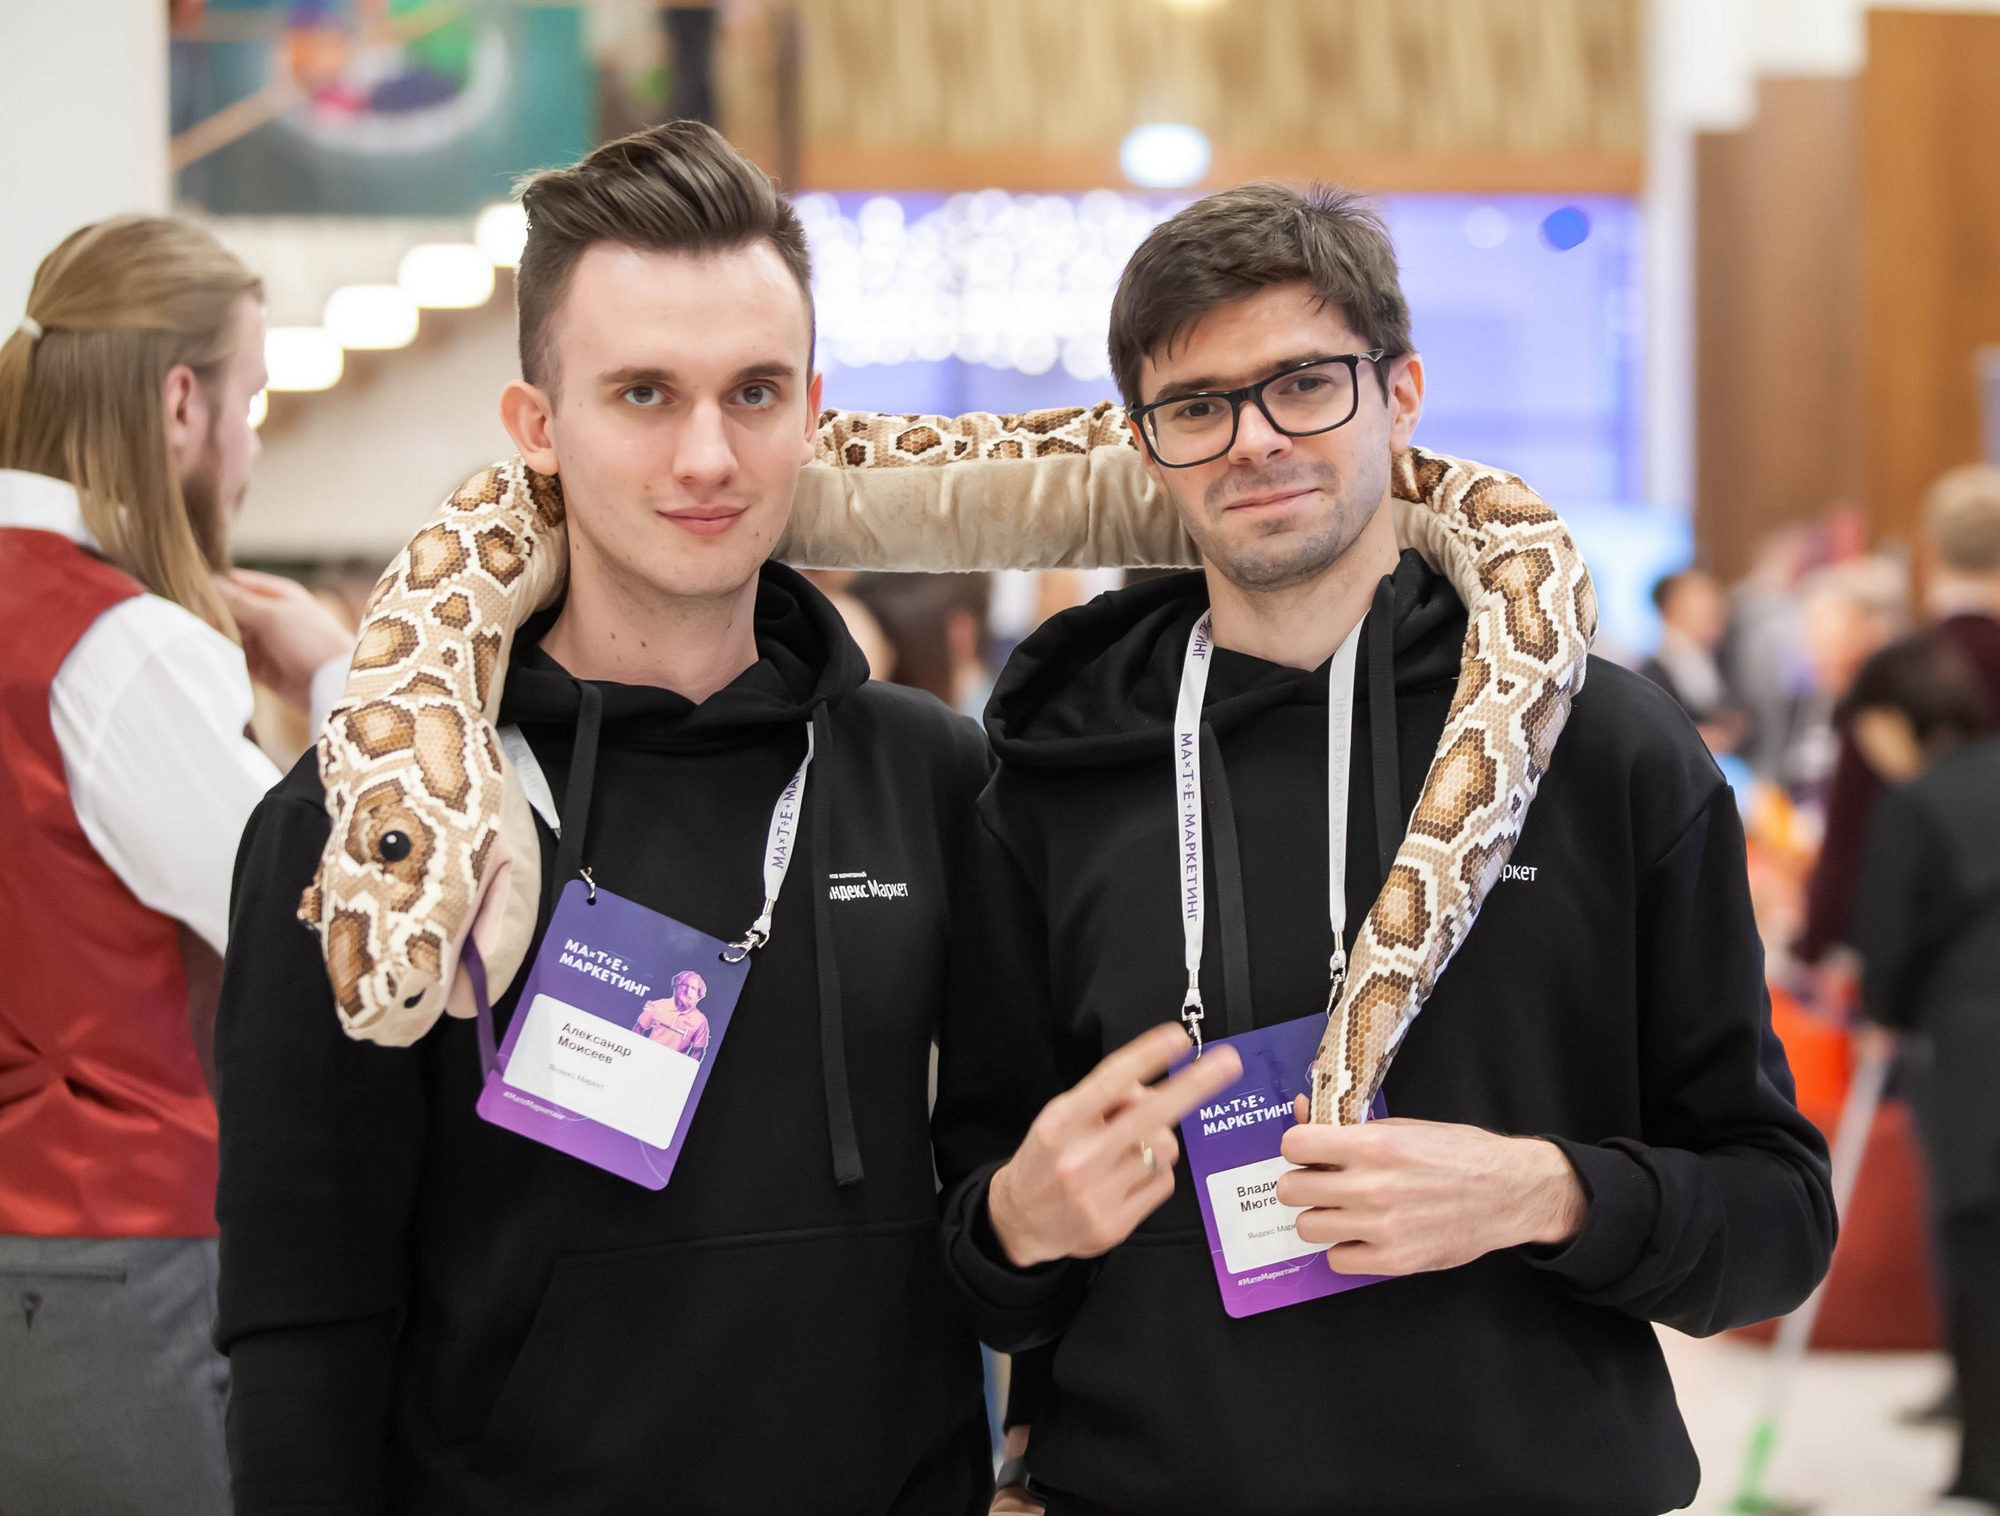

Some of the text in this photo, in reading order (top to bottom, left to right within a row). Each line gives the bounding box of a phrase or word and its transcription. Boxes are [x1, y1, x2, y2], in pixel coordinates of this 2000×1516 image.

[1184, 813, 1198, 922] МАРКЕТИНГ
[1500, 864, 1538, 882] ркет
[867, 879, 909, 901] Маркет
[559, 952, 651, 997] МАРКЕТИНГ
[558, 1035, 613, 1064] Моисеев
[562, 1022, 632, 1057] Александр
[1203, 1101, 1295, 1136] МАРКЕТИНГ
[1236, 1180, 1278, 1198] Влади
[1240, 1197, 1277, 1212] Мюге
[1277, 1223, 1297, 1234] Мар
